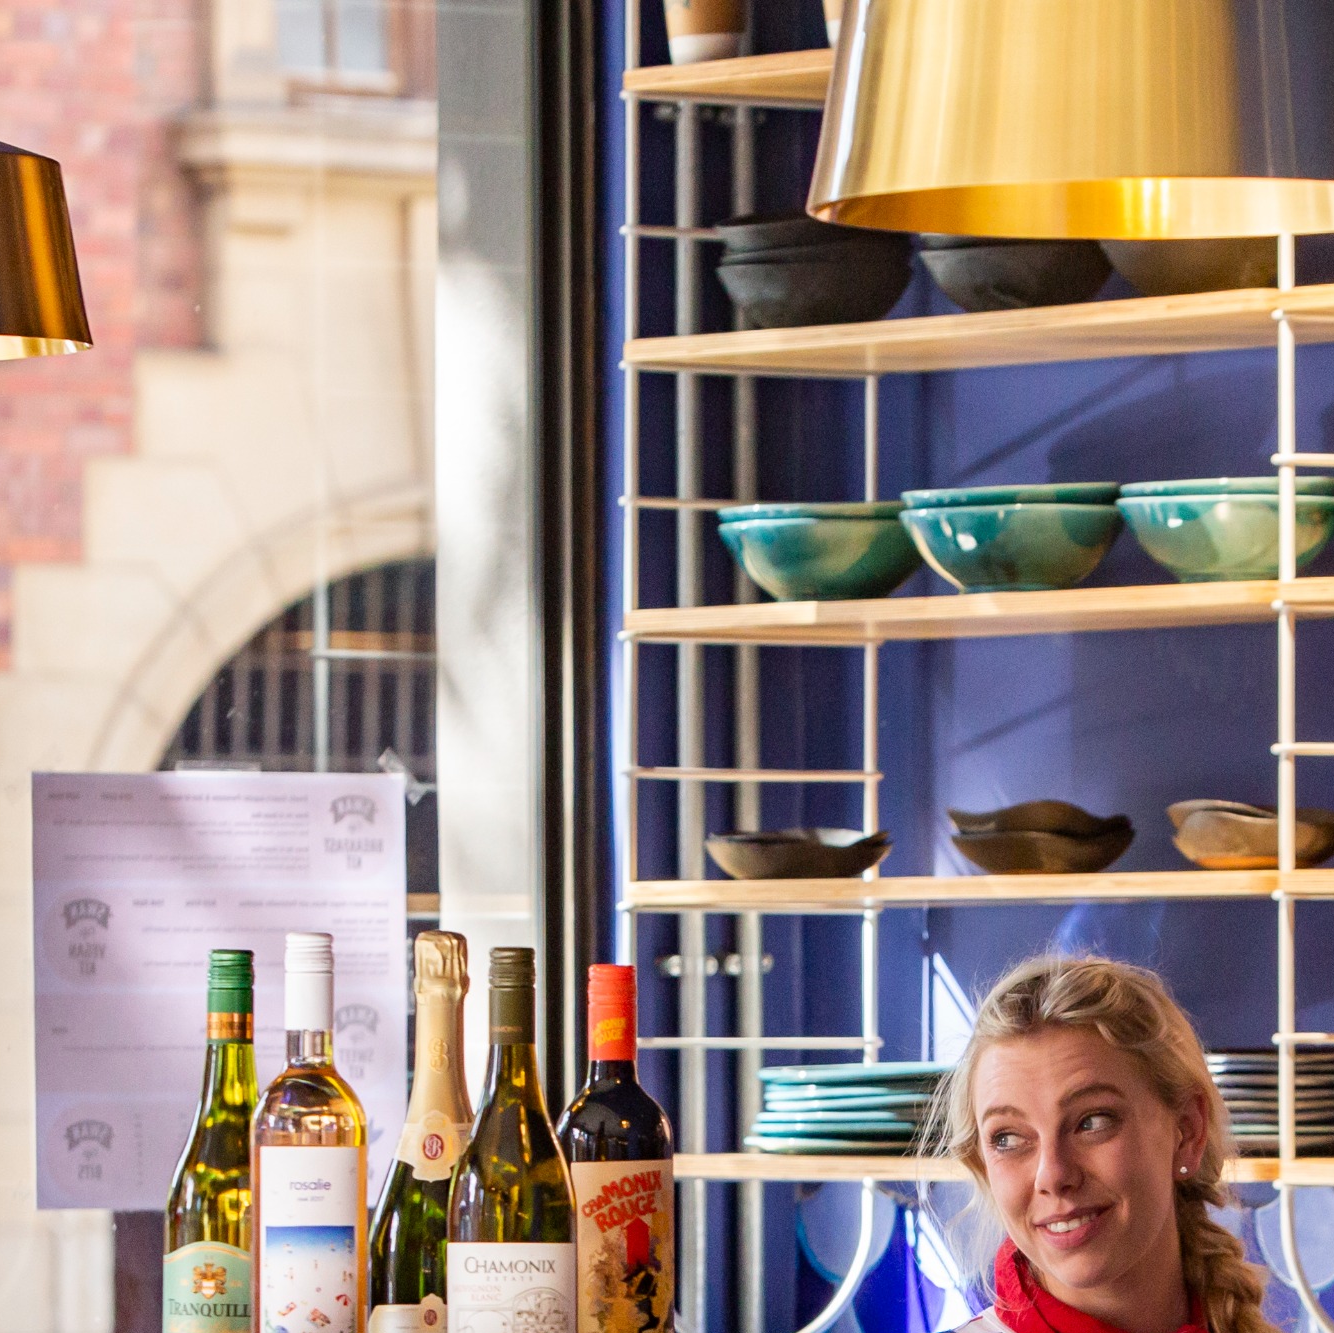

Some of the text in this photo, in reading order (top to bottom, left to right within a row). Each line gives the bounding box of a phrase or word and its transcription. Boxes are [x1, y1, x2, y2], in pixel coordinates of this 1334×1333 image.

[289, 1178, 331, 1190] rosalie
[582, 1170, 662, 1218] CHAMONIX
[595, 1193, 657, 1233] ROUGE
[464, 1256, 556, 1274] CHAMONIX
